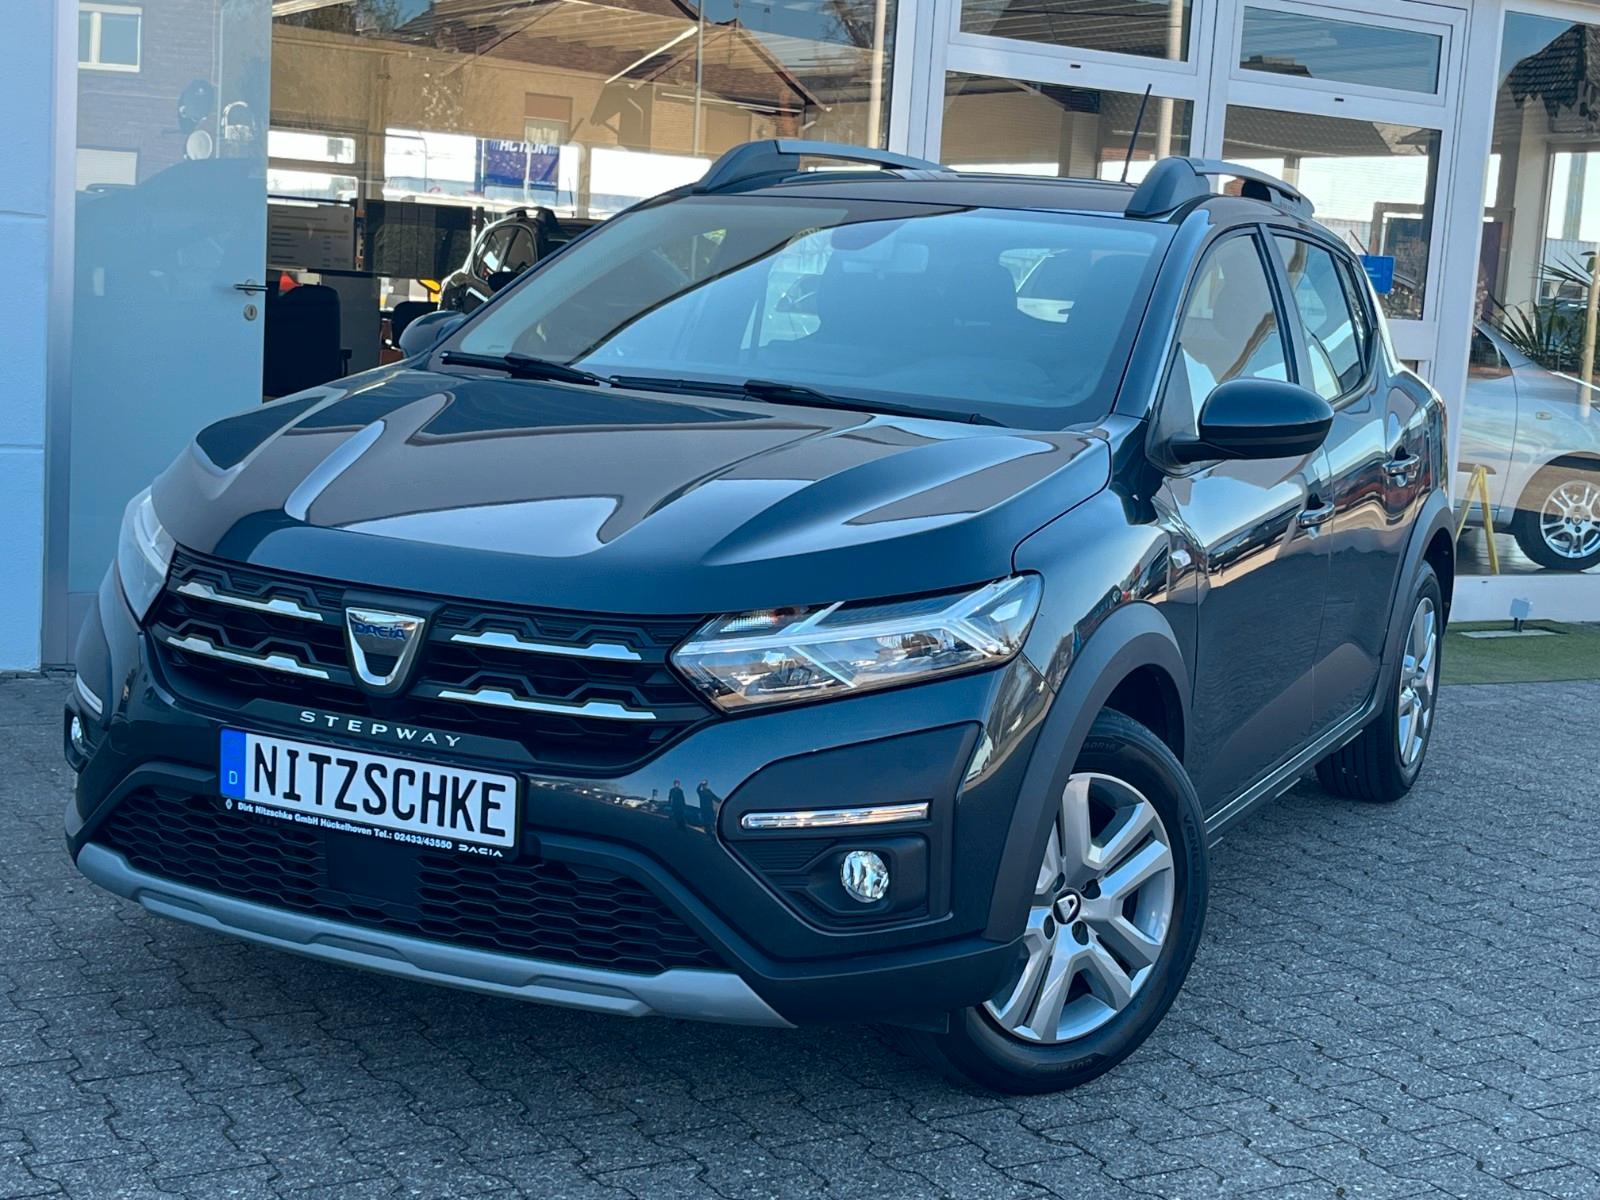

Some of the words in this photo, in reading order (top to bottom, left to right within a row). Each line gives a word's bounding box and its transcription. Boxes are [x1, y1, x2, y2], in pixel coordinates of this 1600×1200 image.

[354, 623, 407, 641] DACIA
[300, 711, 461, 747] STEPWAY
[228, 770, 238, 785] D
[254, 742, 506, 838] NITZSCHKE
[237, 802, 254, 813] Dirk
[255, 806, 293, 821] Nitzschke
[294, 813, 319, 826] GmbH
[320, 818, 372, 836] Hückelhoven
[373, 828, 392, 840] Tel.:
[393, 832, 453, 850] 02433/43550
[458, 844, 504, 858] DACIA
